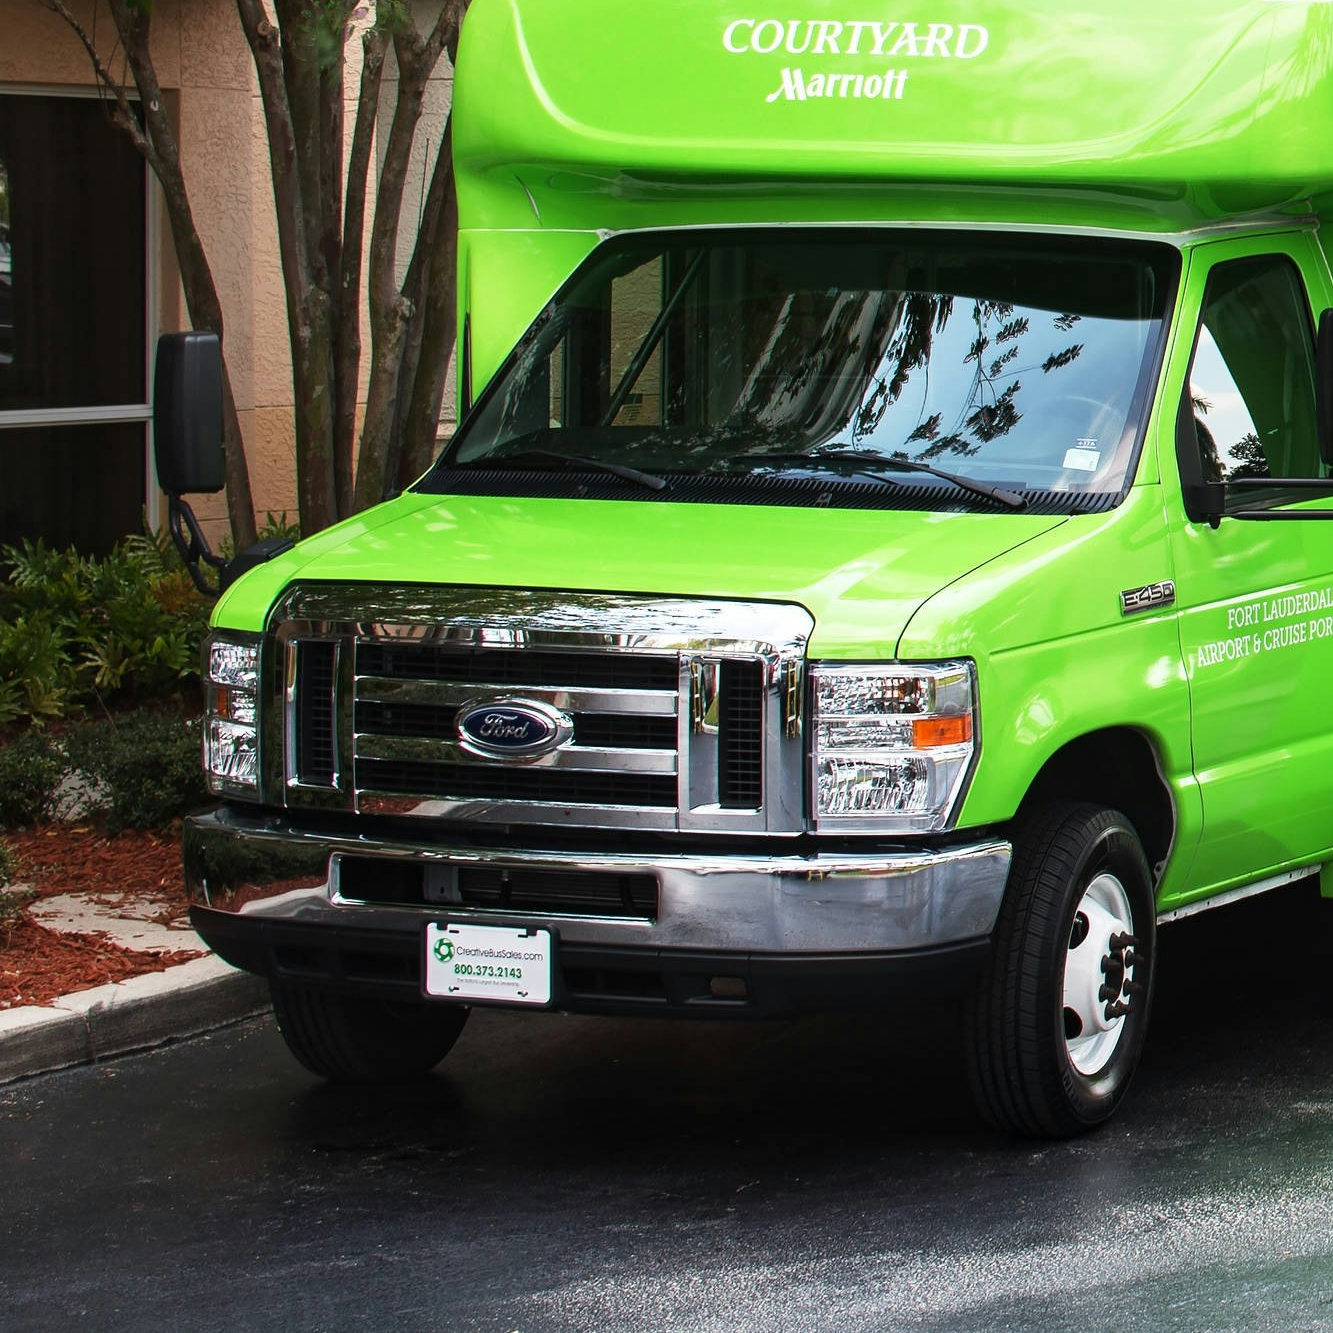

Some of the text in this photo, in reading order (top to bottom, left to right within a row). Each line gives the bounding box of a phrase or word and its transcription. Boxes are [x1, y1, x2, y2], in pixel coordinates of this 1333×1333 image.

[722, 18, 989, 59] COURTYARD
[765, 66, 909, 103] Marriott
[1227, 603, 1261, 629] FORT
[1198, 634, 1251, 667] AIRPORT
[1253, 633, 1262, 654] &
[1263, 623, 1307, 651] CRUISE
[480, 713, 530, 739] Ford
[456, 946, 544, 962] CreativeBusSales.com
[454, 964, 522, 979] 800.373.2143
